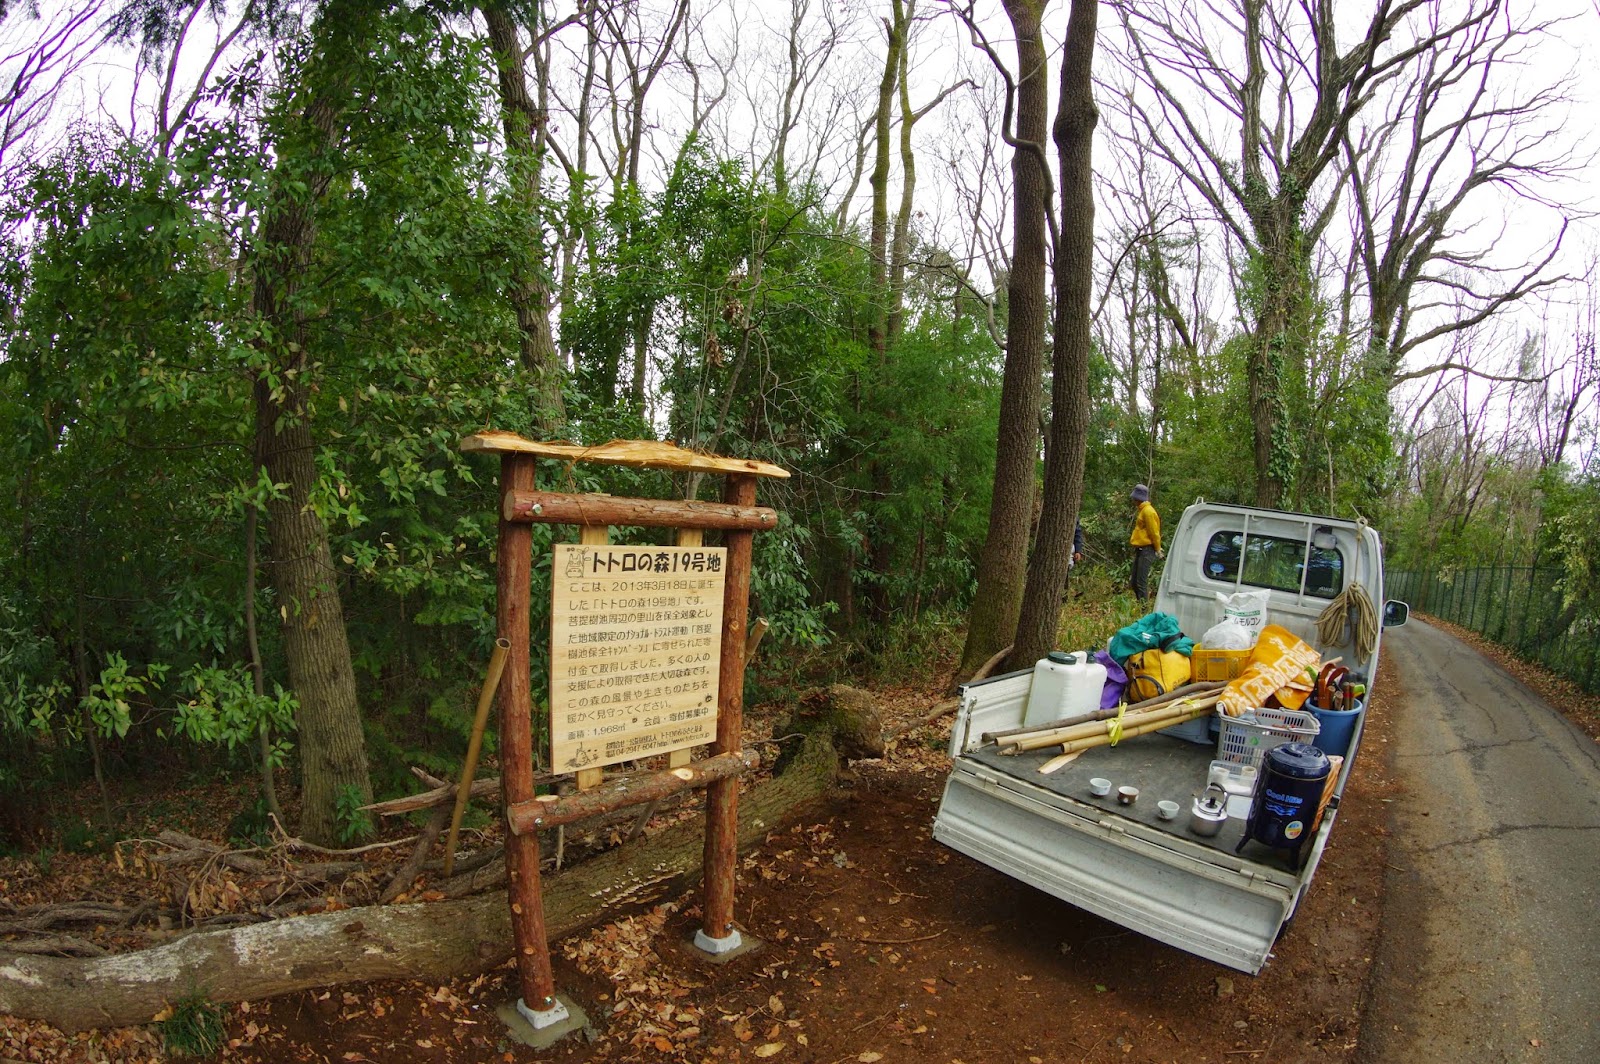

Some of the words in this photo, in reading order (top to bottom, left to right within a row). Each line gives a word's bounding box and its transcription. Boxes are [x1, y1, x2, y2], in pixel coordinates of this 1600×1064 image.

[592, 552, 721, 573] トトロの森19号地
[569, 579, 715, 592] ここは、2013年3月18日に誕生
